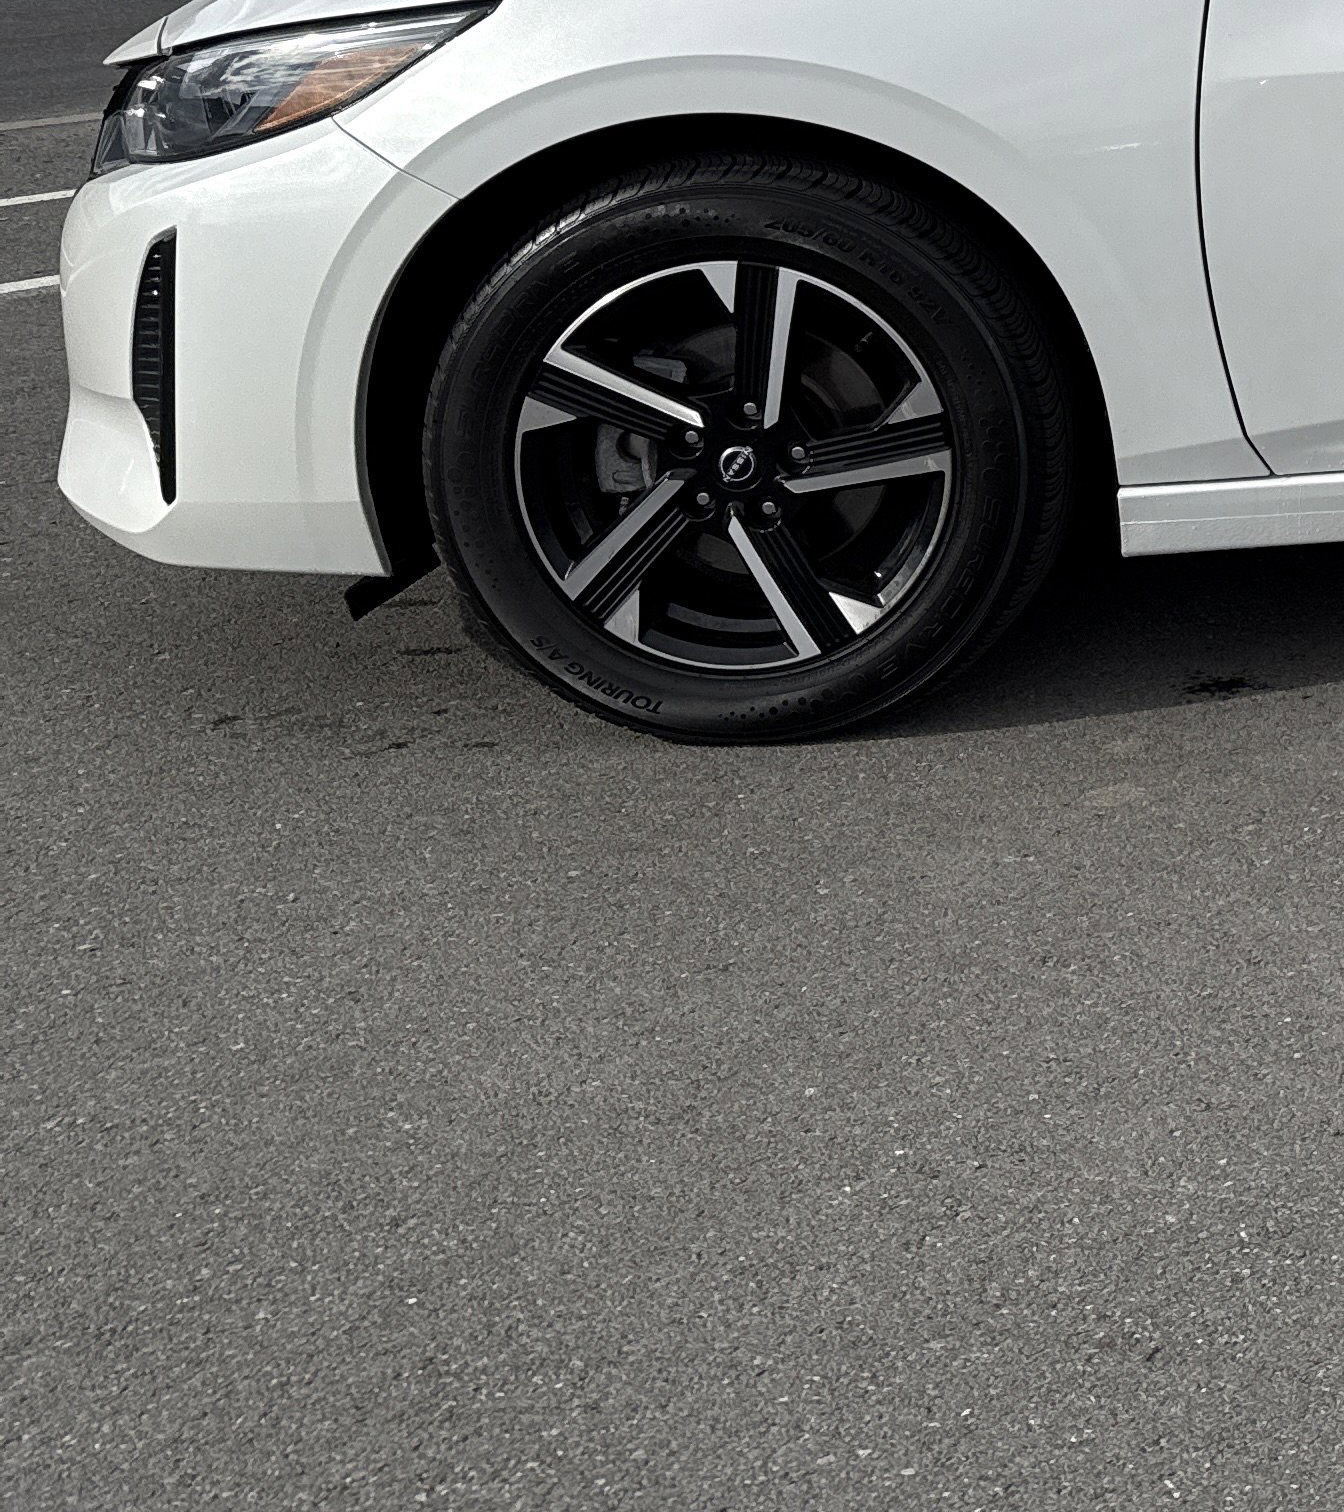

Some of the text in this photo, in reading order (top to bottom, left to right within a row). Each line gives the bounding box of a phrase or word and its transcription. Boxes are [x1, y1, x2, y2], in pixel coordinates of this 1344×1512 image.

[764, 219, 855, 254] 205/60
[722, 445, 754, 483] NISSAN
[529, 635, 664, 715] TOURING A/S
